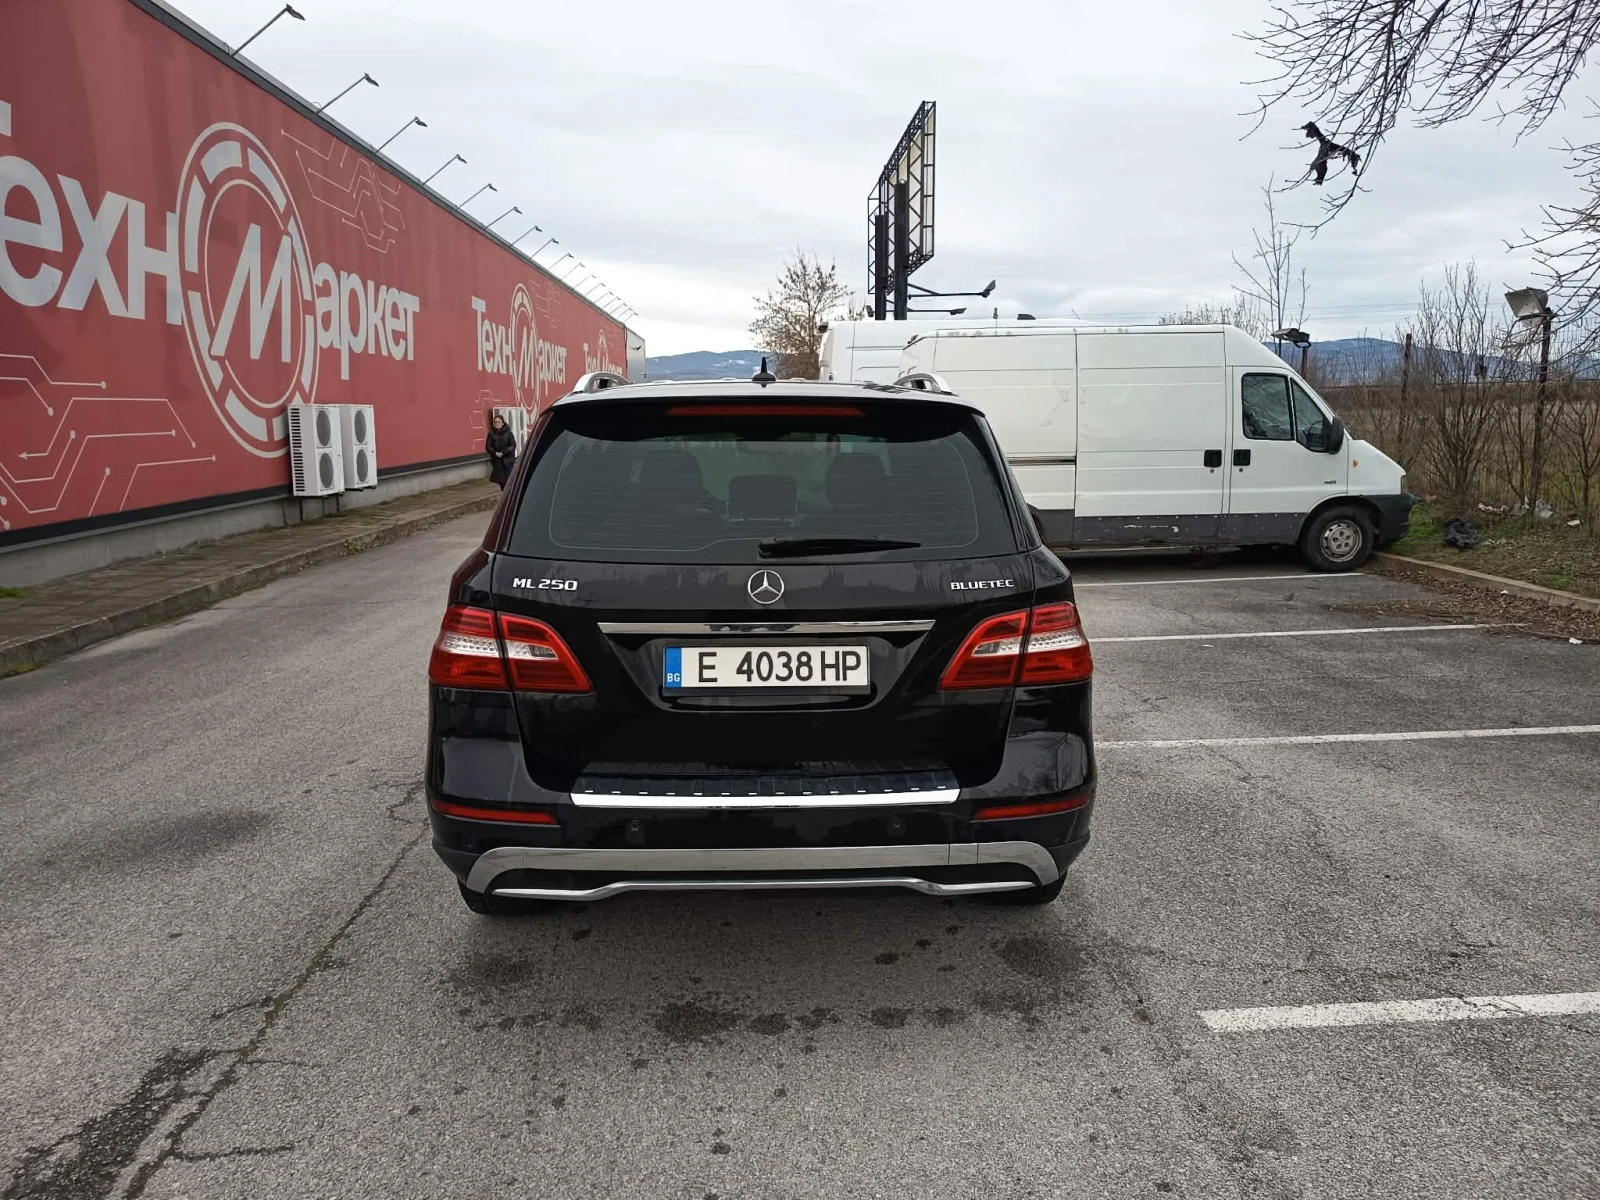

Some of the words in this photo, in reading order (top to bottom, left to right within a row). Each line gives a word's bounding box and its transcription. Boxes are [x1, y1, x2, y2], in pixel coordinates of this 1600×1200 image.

[512, 577, 536, 589] ML
[537, 578, 578, 591] 250
[950, 579, 1015, 590] BLUETEC
[698, 651, 718, 683] E
[666, 673, 681, 683] BG
